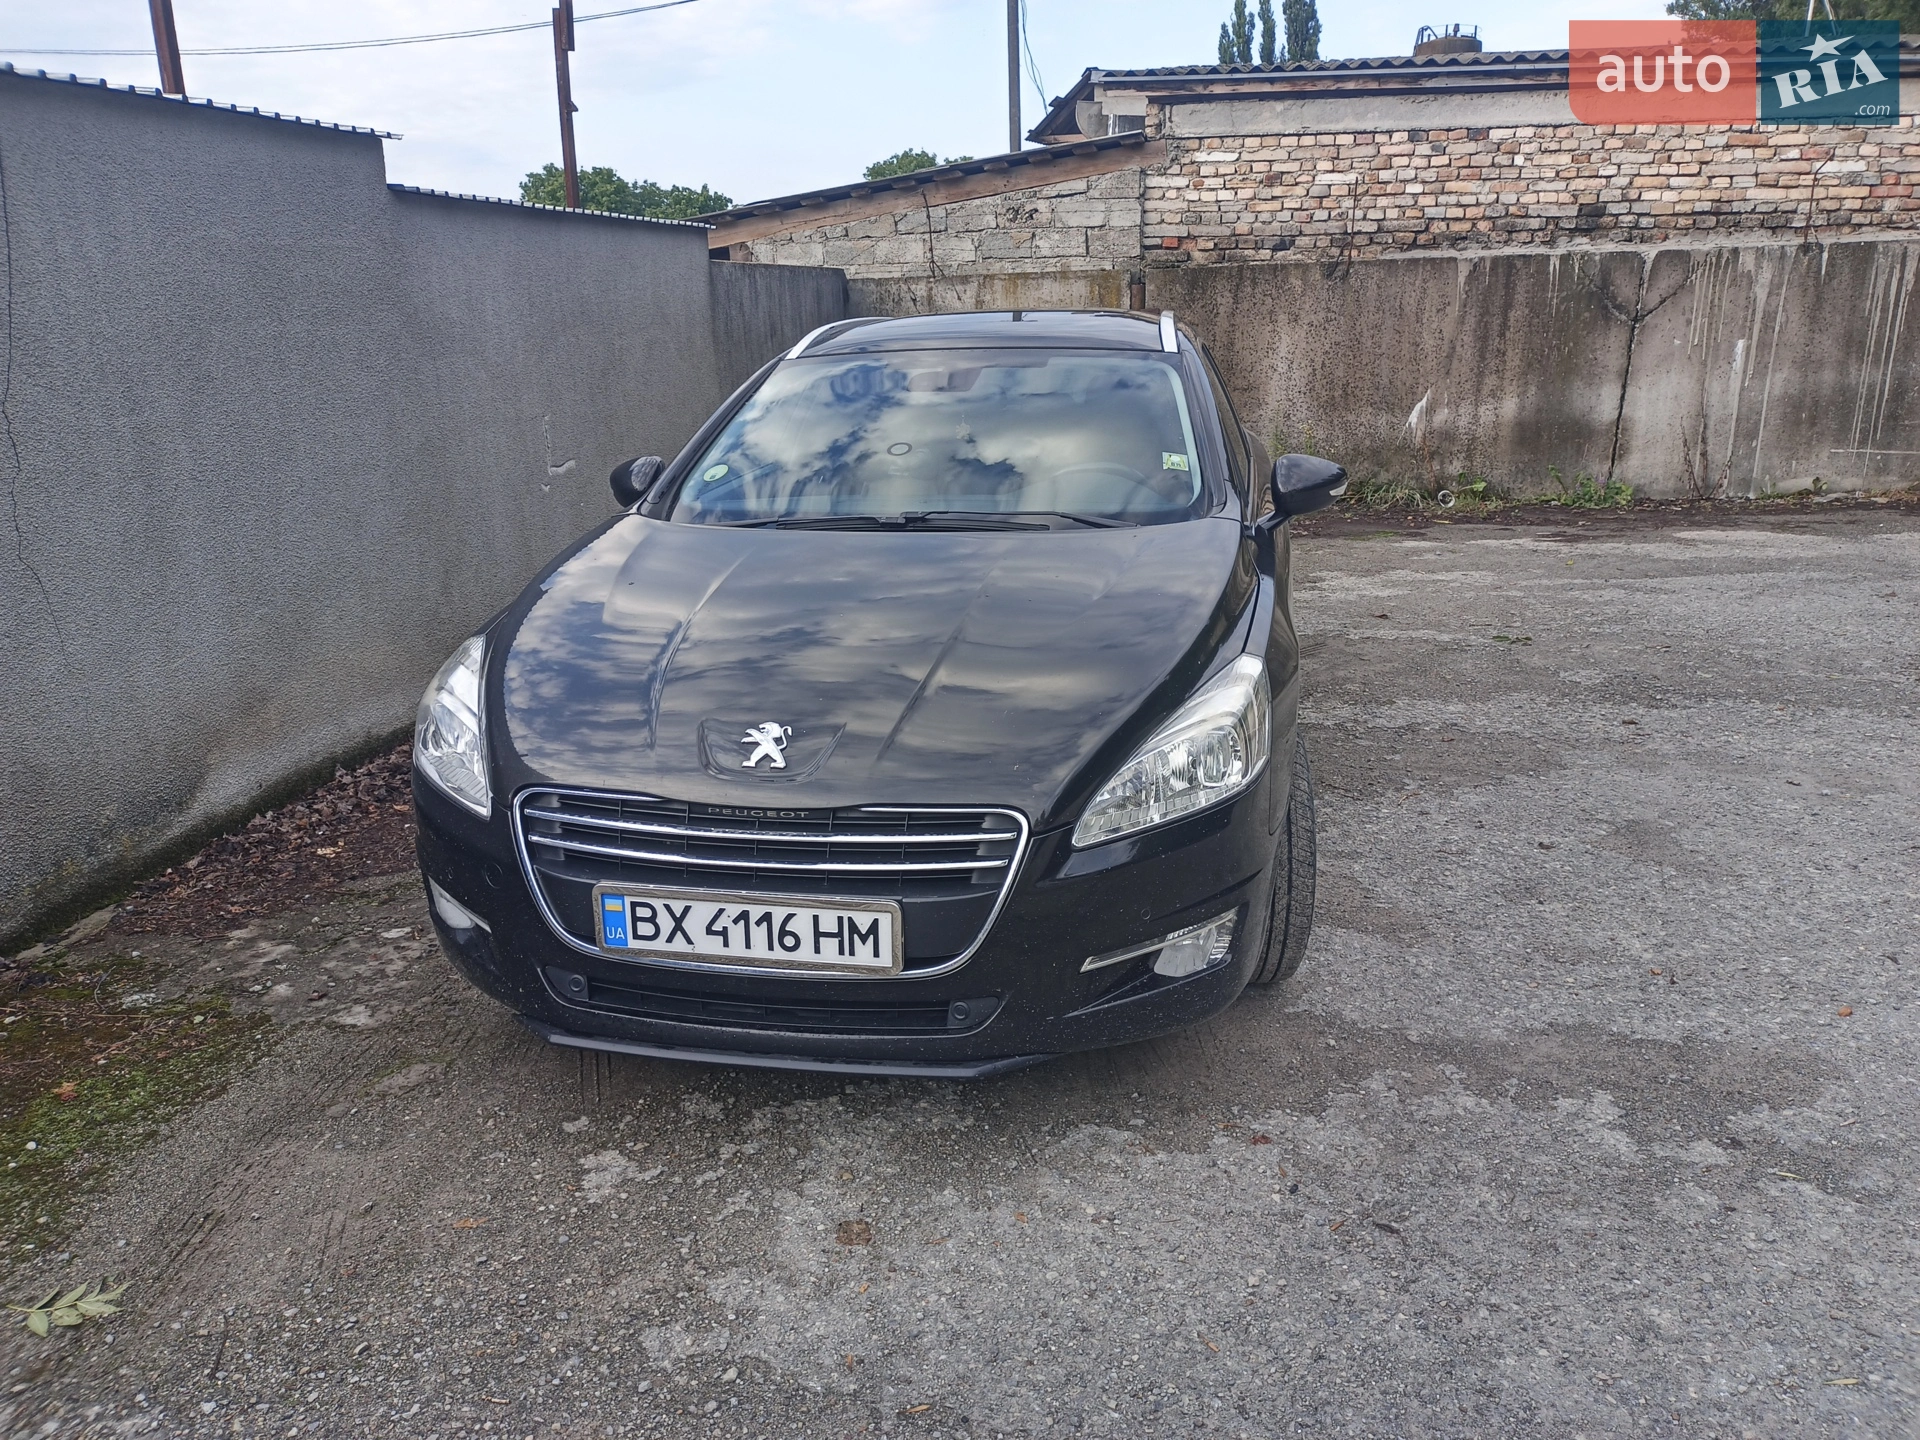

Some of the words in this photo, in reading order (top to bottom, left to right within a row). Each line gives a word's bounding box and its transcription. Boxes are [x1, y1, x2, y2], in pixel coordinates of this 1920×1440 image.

[708, 807, 809, 818] PEUGEOT
[606, 926, 625, 940] UA
[630, 901, 695, 945] BX
[705, 907, 801, 953] 4116
[812, 914, 880, 958] HM
